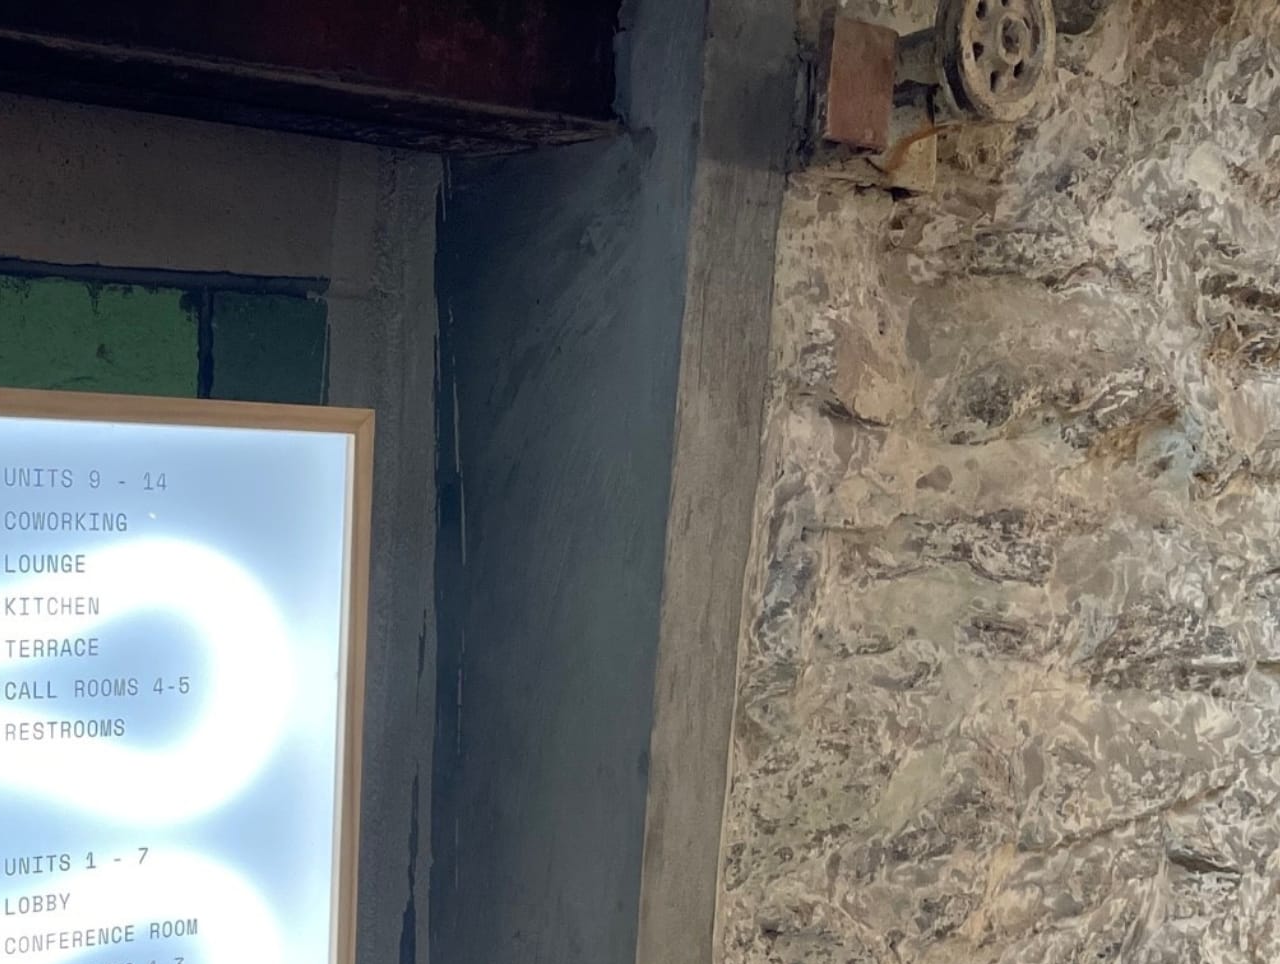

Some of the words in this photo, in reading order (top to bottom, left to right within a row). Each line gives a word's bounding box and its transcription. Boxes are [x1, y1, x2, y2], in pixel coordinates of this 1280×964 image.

[5, 467, 74, 488] UNITS
[89, 469, 100, 488] 9
[143, 472, 167, 491] 14
[5, 511, 127, 532] COWORKING
[5, 554, 85, 573] LOUNGE
[5, 597, 99, 616] KITCHEN
[5, 638, 98, 658] TERRACE
[5, 680, 58, 700] CALL
[74, 678, 138, 698] ROOMS
[153, 676, 190, 694] 4-5
[6, 719, 125, 740] RESTROOMS
[5, 854, 70, 876] UNITS
[86, 852, 96, 869] 1
[138, 847, 148, 864] 7
[5, 893, 70, 916] LOBBY
[5, 925, 134, 954] CONFERENCE
[150, 918, 197, 939] ROOM
